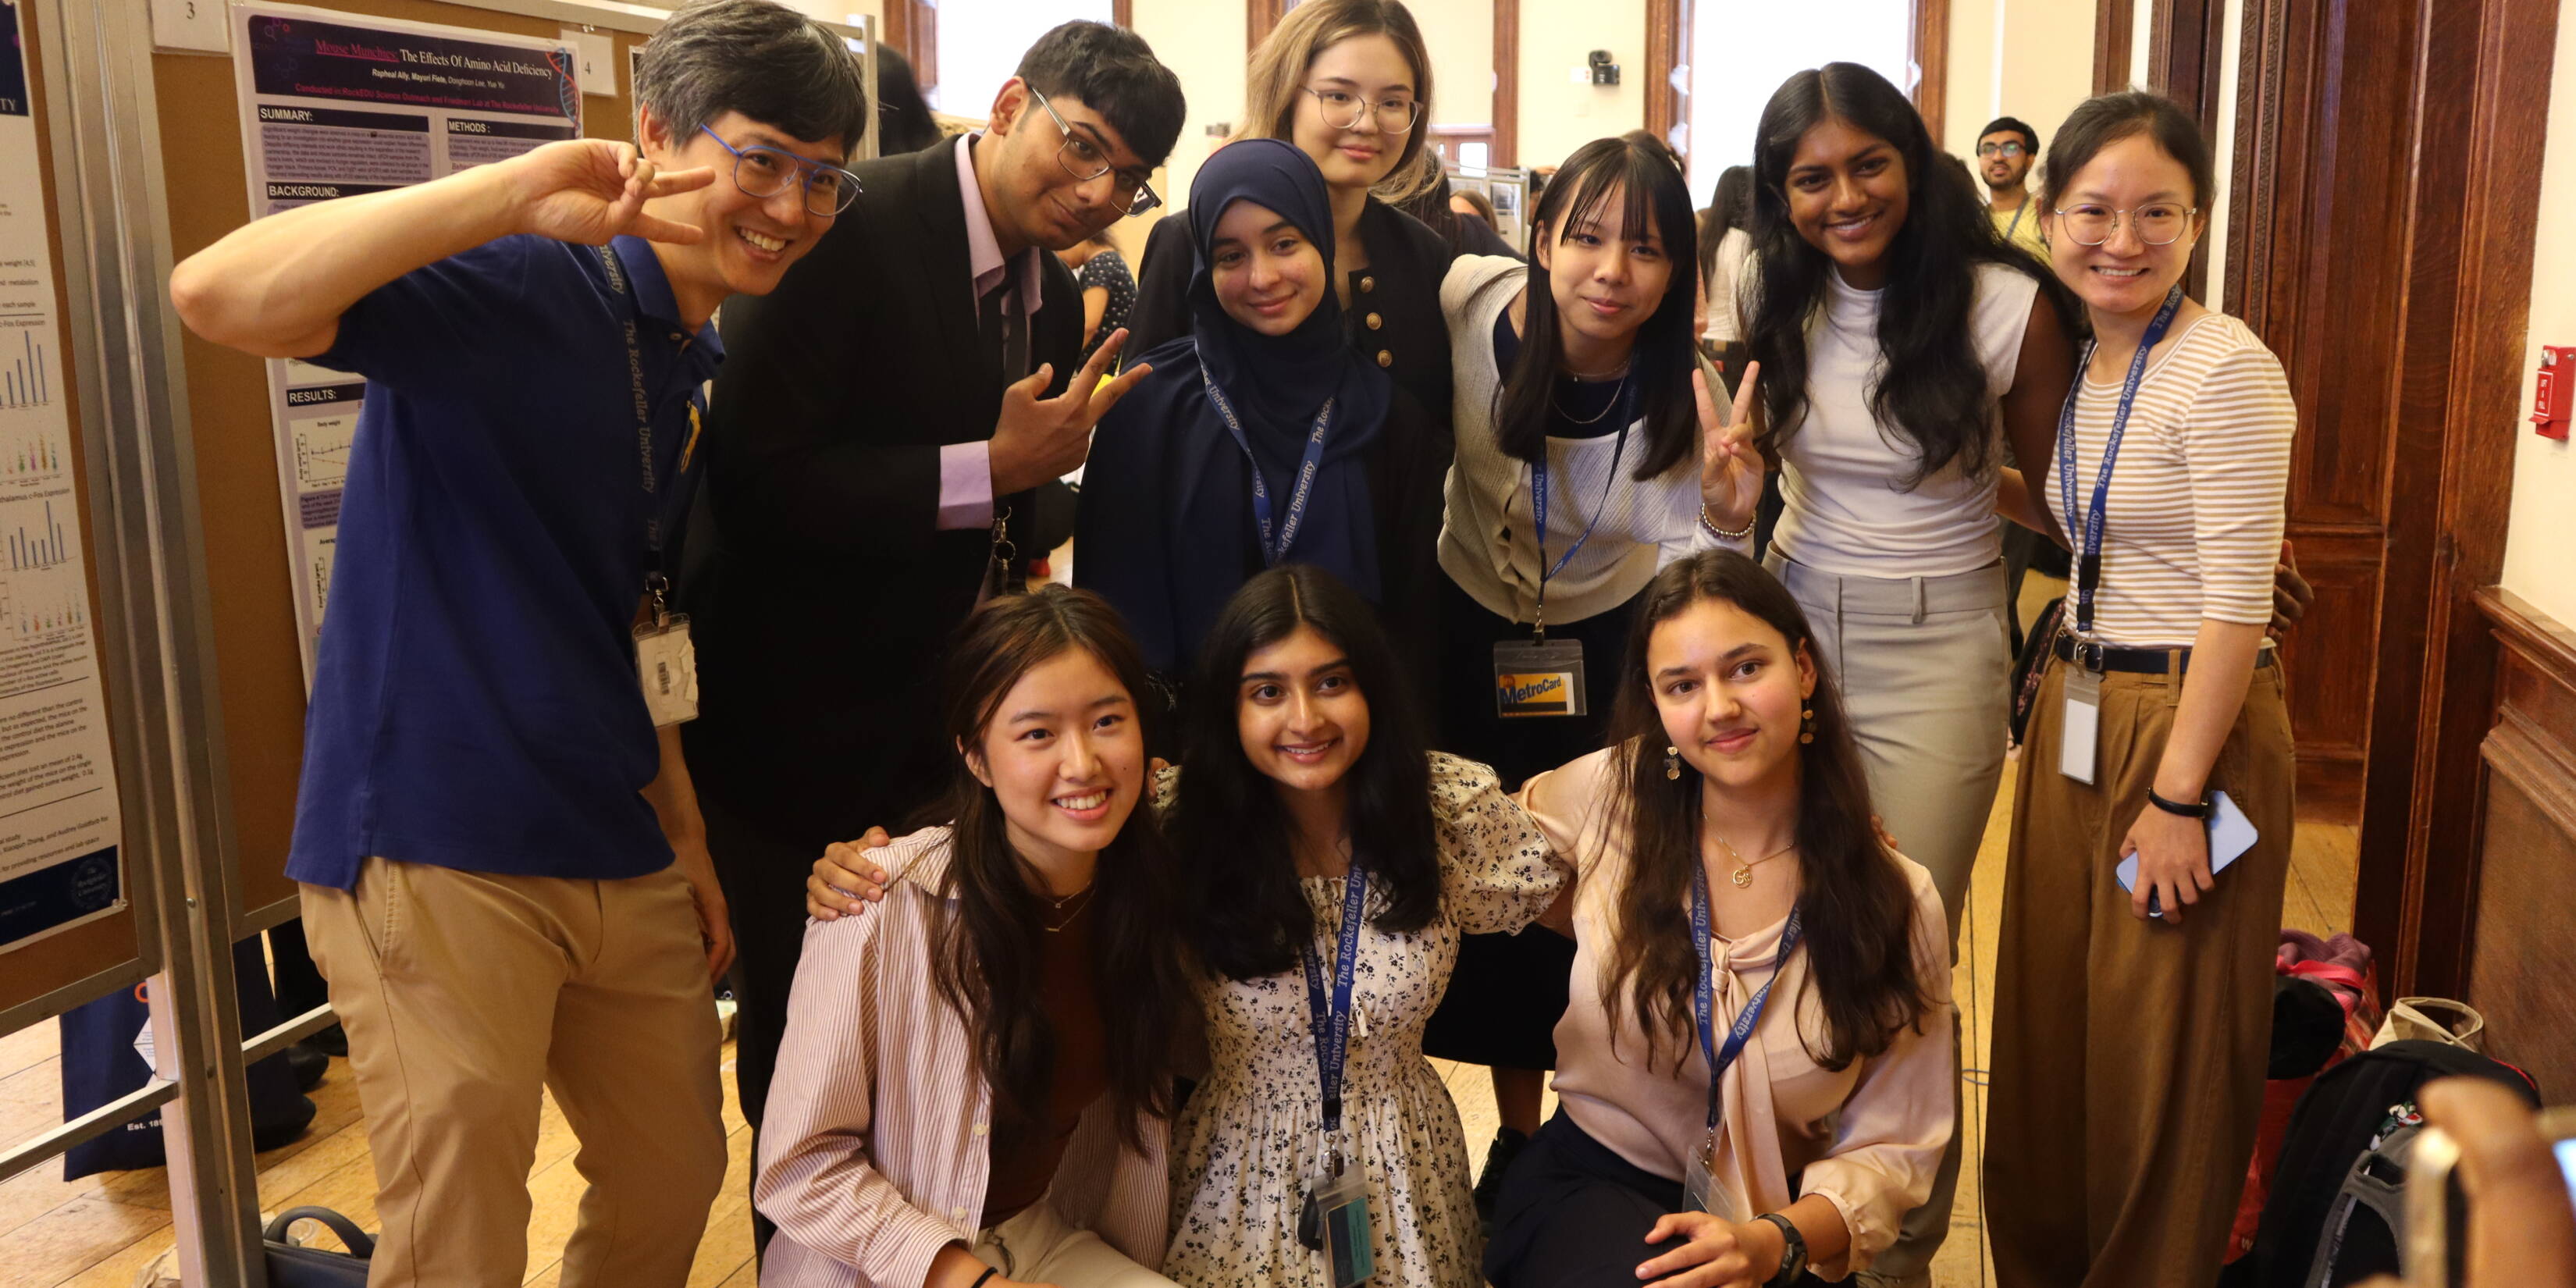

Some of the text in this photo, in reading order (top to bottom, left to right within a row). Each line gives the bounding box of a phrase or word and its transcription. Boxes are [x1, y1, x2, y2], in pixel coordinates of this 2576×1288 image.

[187, 2, 195, 20] 3
[315, 40, 348, 54] Mouse
[400, 49, 418, 62] The
[420, 52, 448, 65] Effects
[450, 55, 463, 66] Of
[464, 58, 491, 70] Amino
[493, 61, 510, 72] Acid
[512, 62, 552, 78] Deficiency
[585, 62, 592, 74] 4
[260, 109, 312, 121] SUMMARY:
[448, 121, 486, 132] METHODS
[269, 187, 339, 197] BACKGROUND:
[289, 390, 336, 402] RESULTS:
[623, 319, 656, 493] The Rockefeller University
[1209, 385, 1241, 431] University
[2096, 464, 2109, 490] The
[2104, 402, 2127, 466] Rockefeller
[2122, 345, 2147, 401] University
[1291, 460, 1316, 513] University
[1311, 426, 1325, 445] The
[1534, 473, 1544, 525] University
[2064, 464, 2075, 518] University
[1500, 675, 1562, 705] MetroCard
[1336, 888, 1359, 988] The Rockefeller
[1315, 1012, 1326, 1034] The
[1697, 1002, 1709, 1026] The
[1329, 1009, 1348, 1070] University
